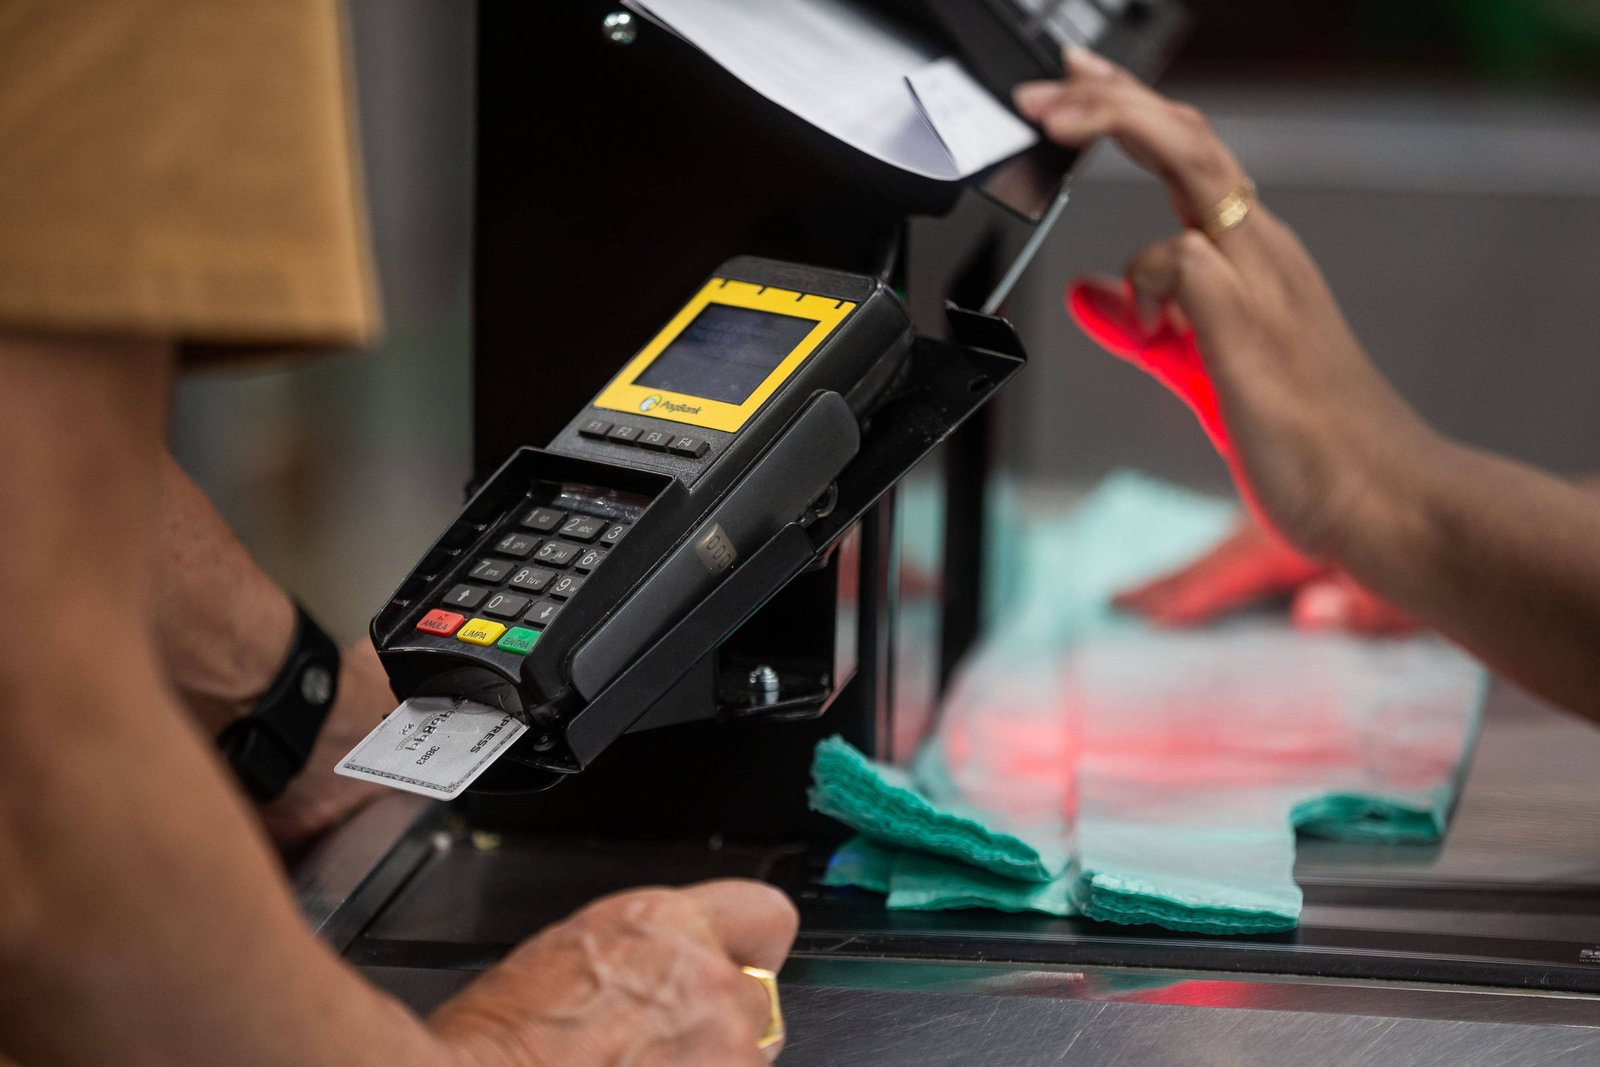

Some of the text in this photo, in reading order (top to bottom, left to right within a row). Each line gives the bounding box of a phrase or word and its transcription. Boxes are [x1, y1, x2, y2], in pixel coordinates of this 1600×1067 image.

[659, 401, 702, 415] PagBank
[588, 420, 693, 448] F1 F2 F3 F4
[527, 510, 539, 523] 1
[564, 518, 580, 531] 2
[607, 526, 623, 539] 3
[501, 535, 516, 548] 4
[539, 543, 556, 557] 5
[582, 552, 597, 565] 6
[474, 560, 491, 574] 7
[513, 569, 529, 583] 8
[556, 578, 572, 592] 9
[488, 595, 504, 608] 0
[421, 619, 448, 631] ANULA
[462, 628, 487, 640] LIMPA
[503, 637, 530, 649] ENTRA
[470, 711, 513, 754] XPRESS
